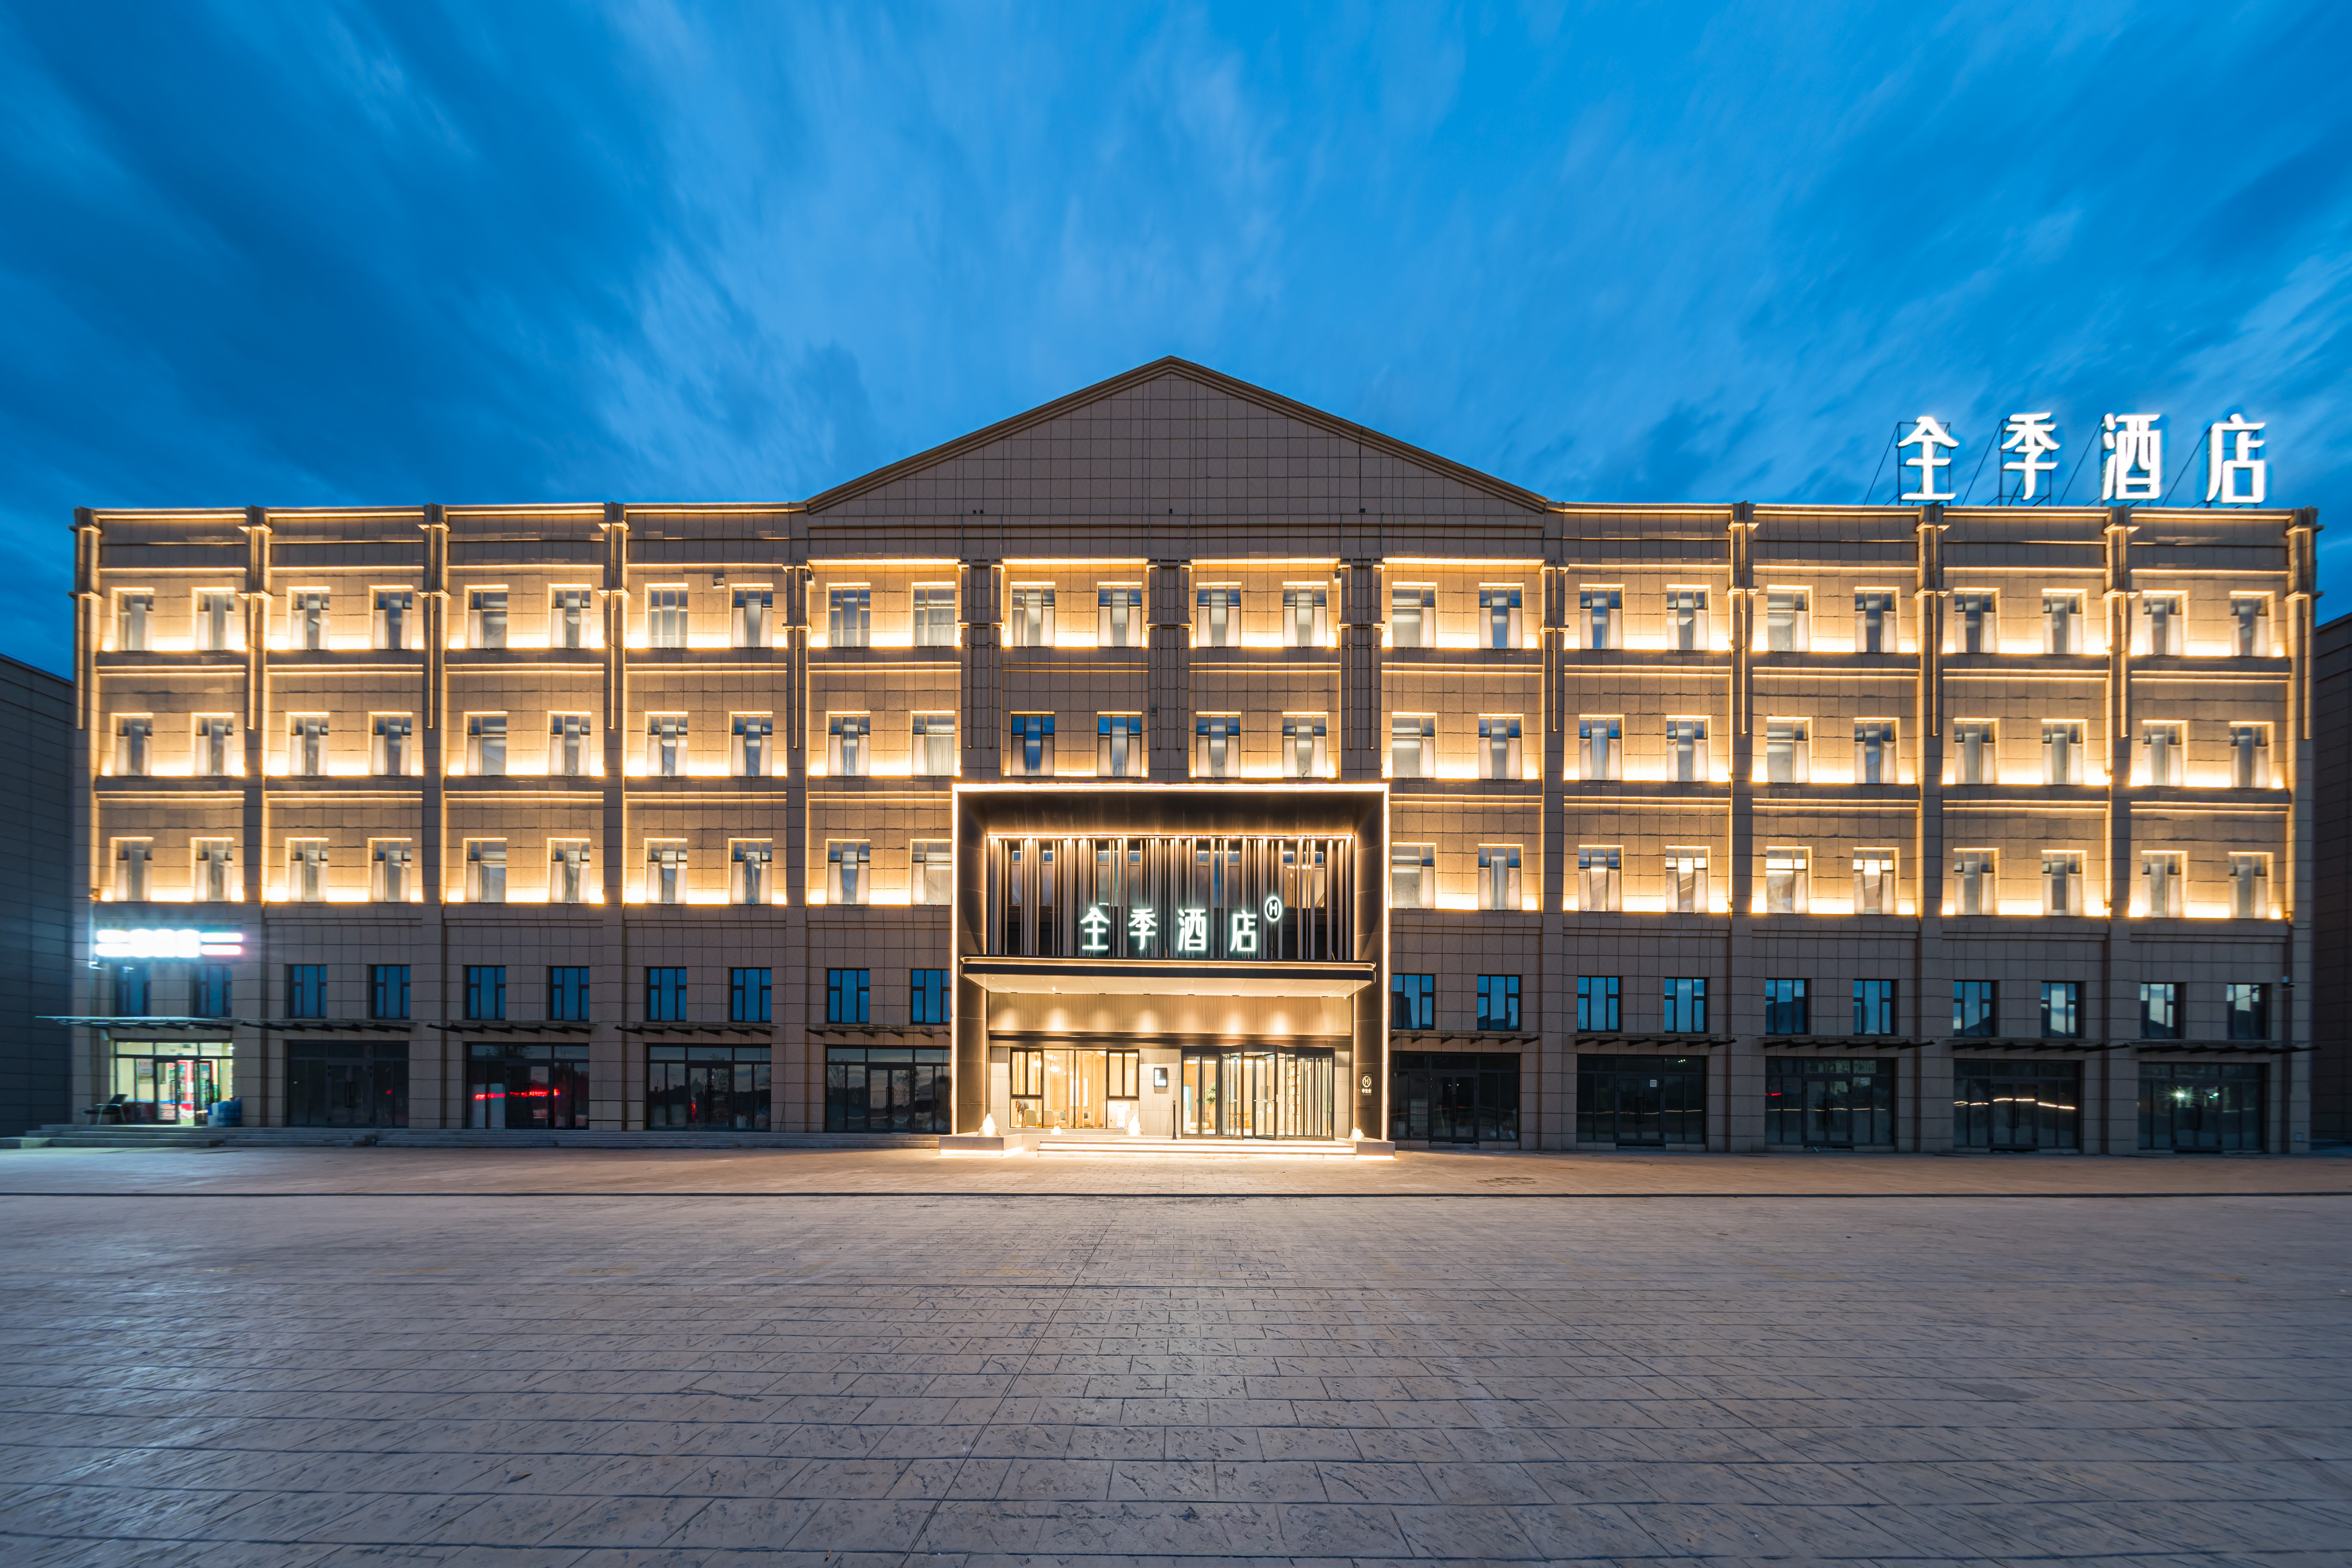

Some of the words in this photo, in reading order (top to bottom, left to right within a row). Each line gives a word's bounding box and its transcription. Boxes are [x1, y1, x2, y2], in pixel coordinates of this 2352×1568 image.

[1897, 412, 2266, 504] 全季酒店
[1080, 907, 1257, 952] 全季酒店
